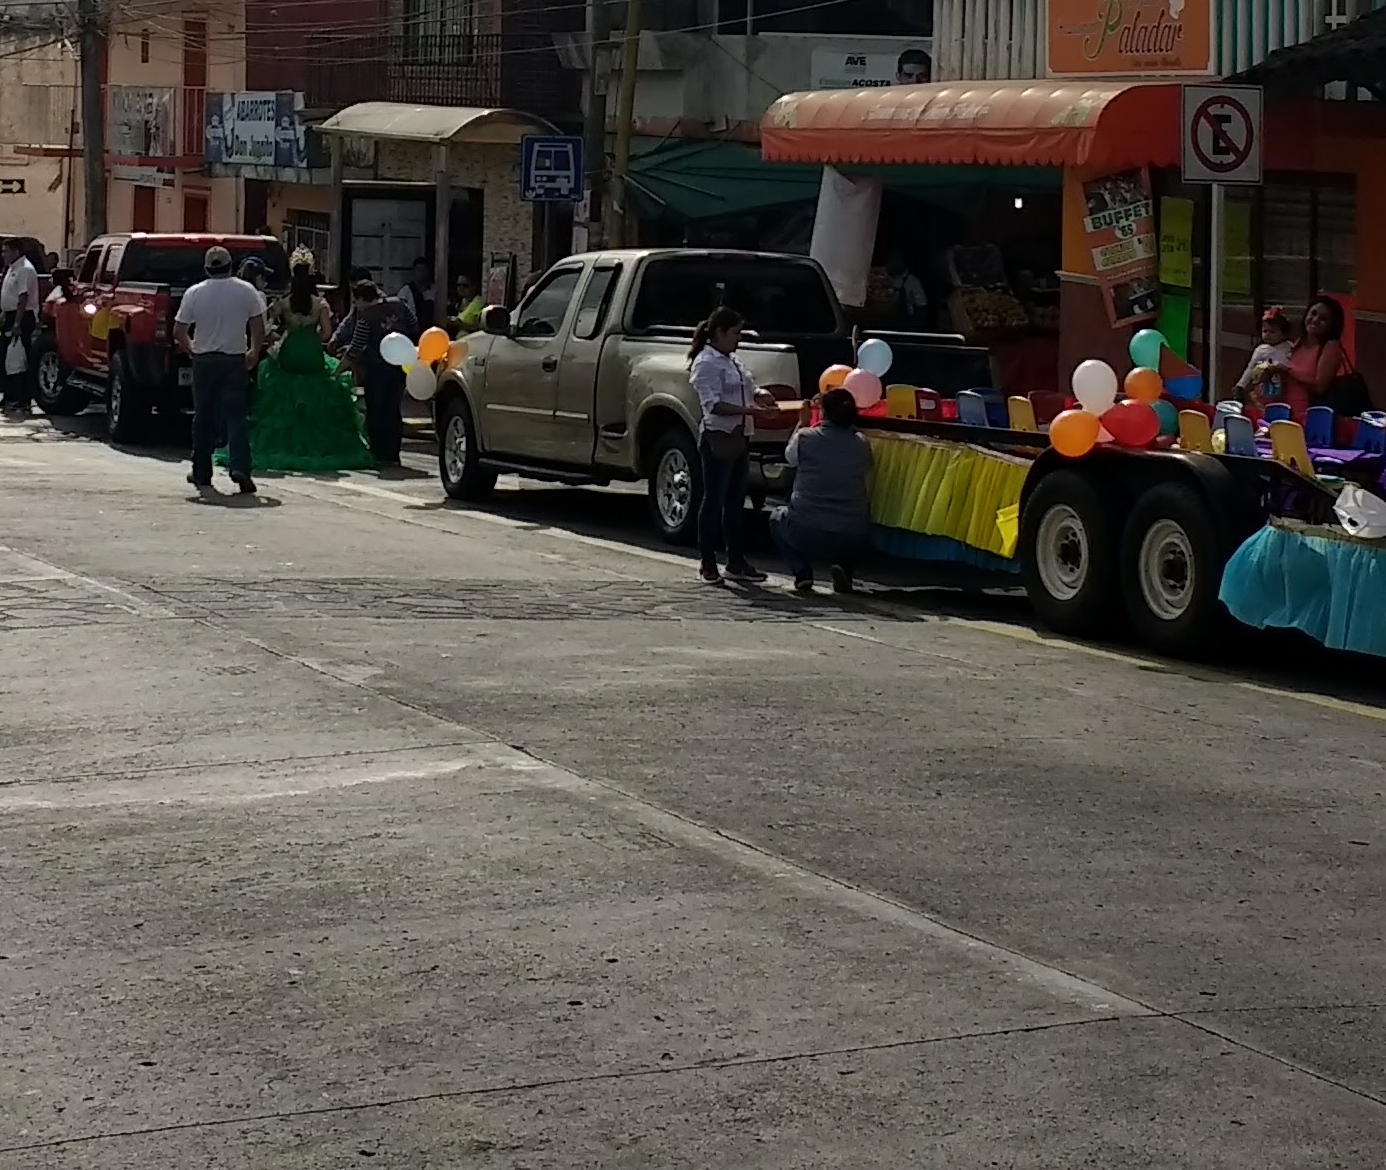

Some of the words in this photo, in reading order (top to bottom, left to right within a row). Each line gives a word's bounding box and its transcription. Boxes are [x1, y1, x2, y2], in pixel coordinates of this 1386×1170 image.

[845, 56, 867, 66] AVE
[852, 78, 891, 87] ACOSTA
[1213, 114, 1232, 155] E
[1091, 202, 1152, 231] BUFFET
